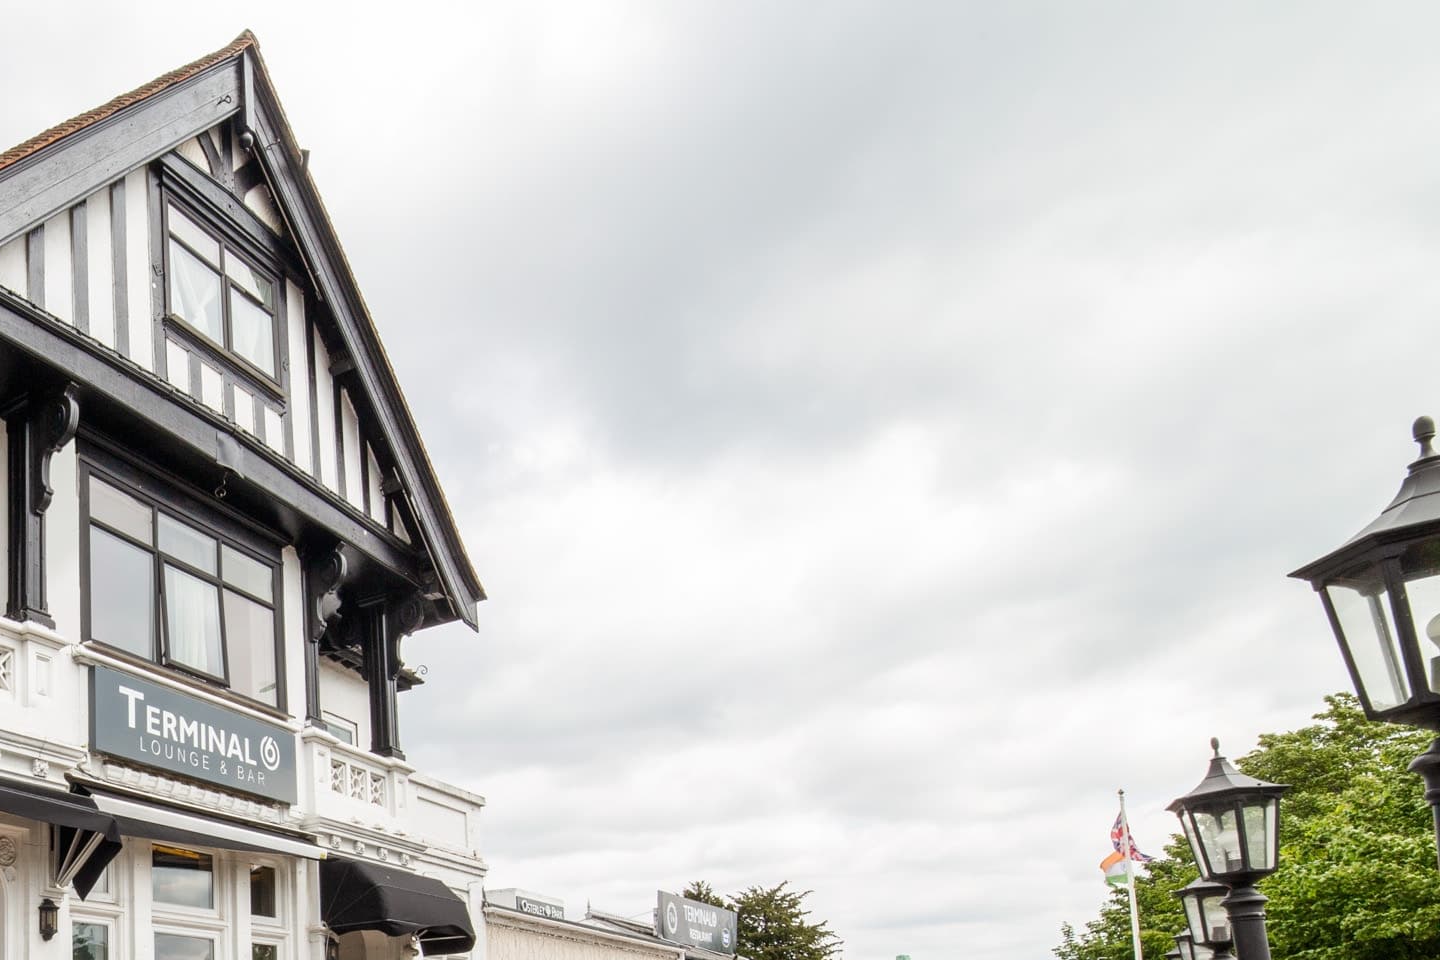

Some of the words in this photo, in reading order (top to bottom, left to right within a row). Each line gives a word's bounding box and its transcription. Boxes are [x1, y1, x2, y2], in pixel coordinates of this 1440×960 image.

[118, 685, 258, 766] TERMINAL
[139, 735, 210, 770] LOUNGE
[220, 760, 227, 775] &
[237, 765, 265, 785] BAR
